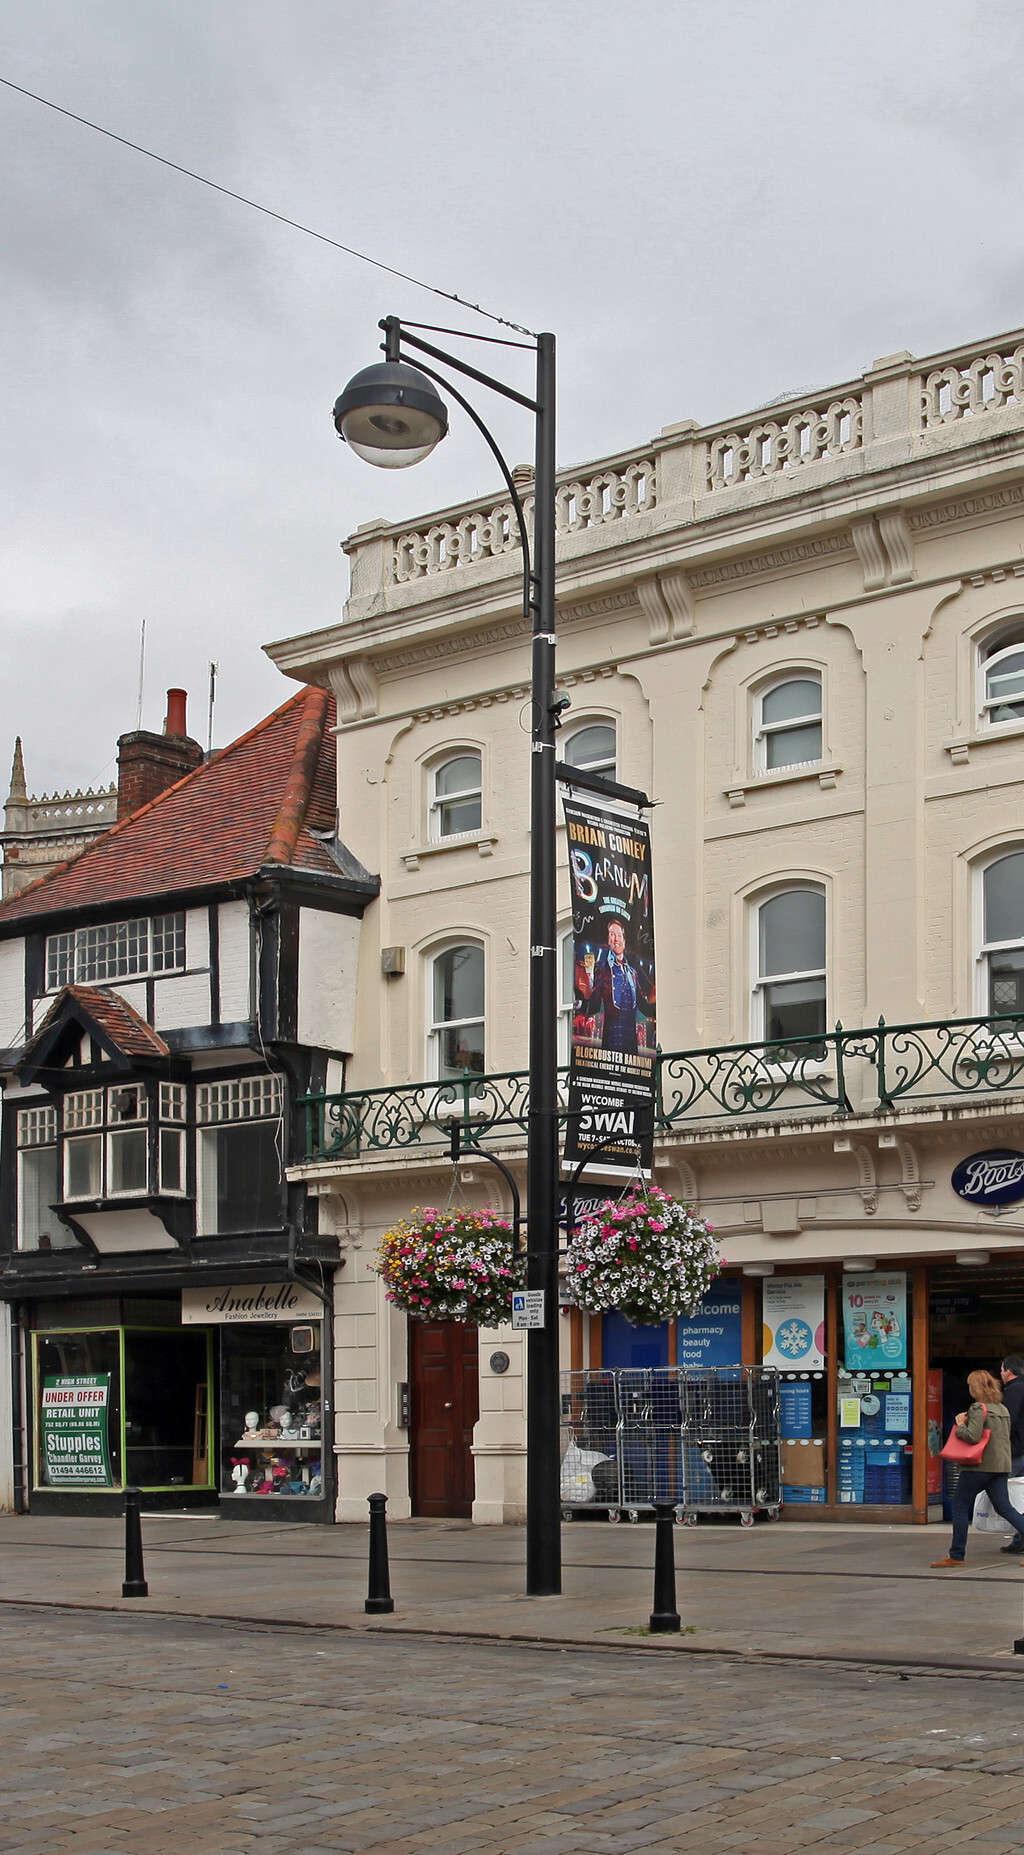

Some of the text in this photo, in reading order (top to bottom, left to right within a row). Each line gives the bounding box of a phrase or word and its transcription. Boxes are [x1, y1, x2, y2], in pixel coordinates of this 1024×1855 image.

[568, 821, 607, 849] BRIAN
[608, 832, 646, 861] CONLEY
[570, 848, 649, 918] BARNUM
[581, 1093, 624, 1107] WYCOMBE
[578, 1132, 590, 1142] TUE
[206, 1284, 298, 1312] Anabelle
[848, 1294, 864, 1308] 10
[692, 1304, 740, 1315] elcome
[250, 1312, 278, 1320] Jewellery
[683, 1326, 724, 1336] pharmacy
[683, 1338, 711, 1348] beauty
[683, 1350, 702, 1358] food
[76, 1377, 97, 1385] STREET
[45, 1390, 104, 1403] UNDER OFFER
[46, 1407, 100, 1418] RETAIL UNIT
[47, 1433, 101, 1453] Stupples
[49, 1453, 102, 1464] Chandler Garvey
[51, 1466, 74, 1474] 01494
